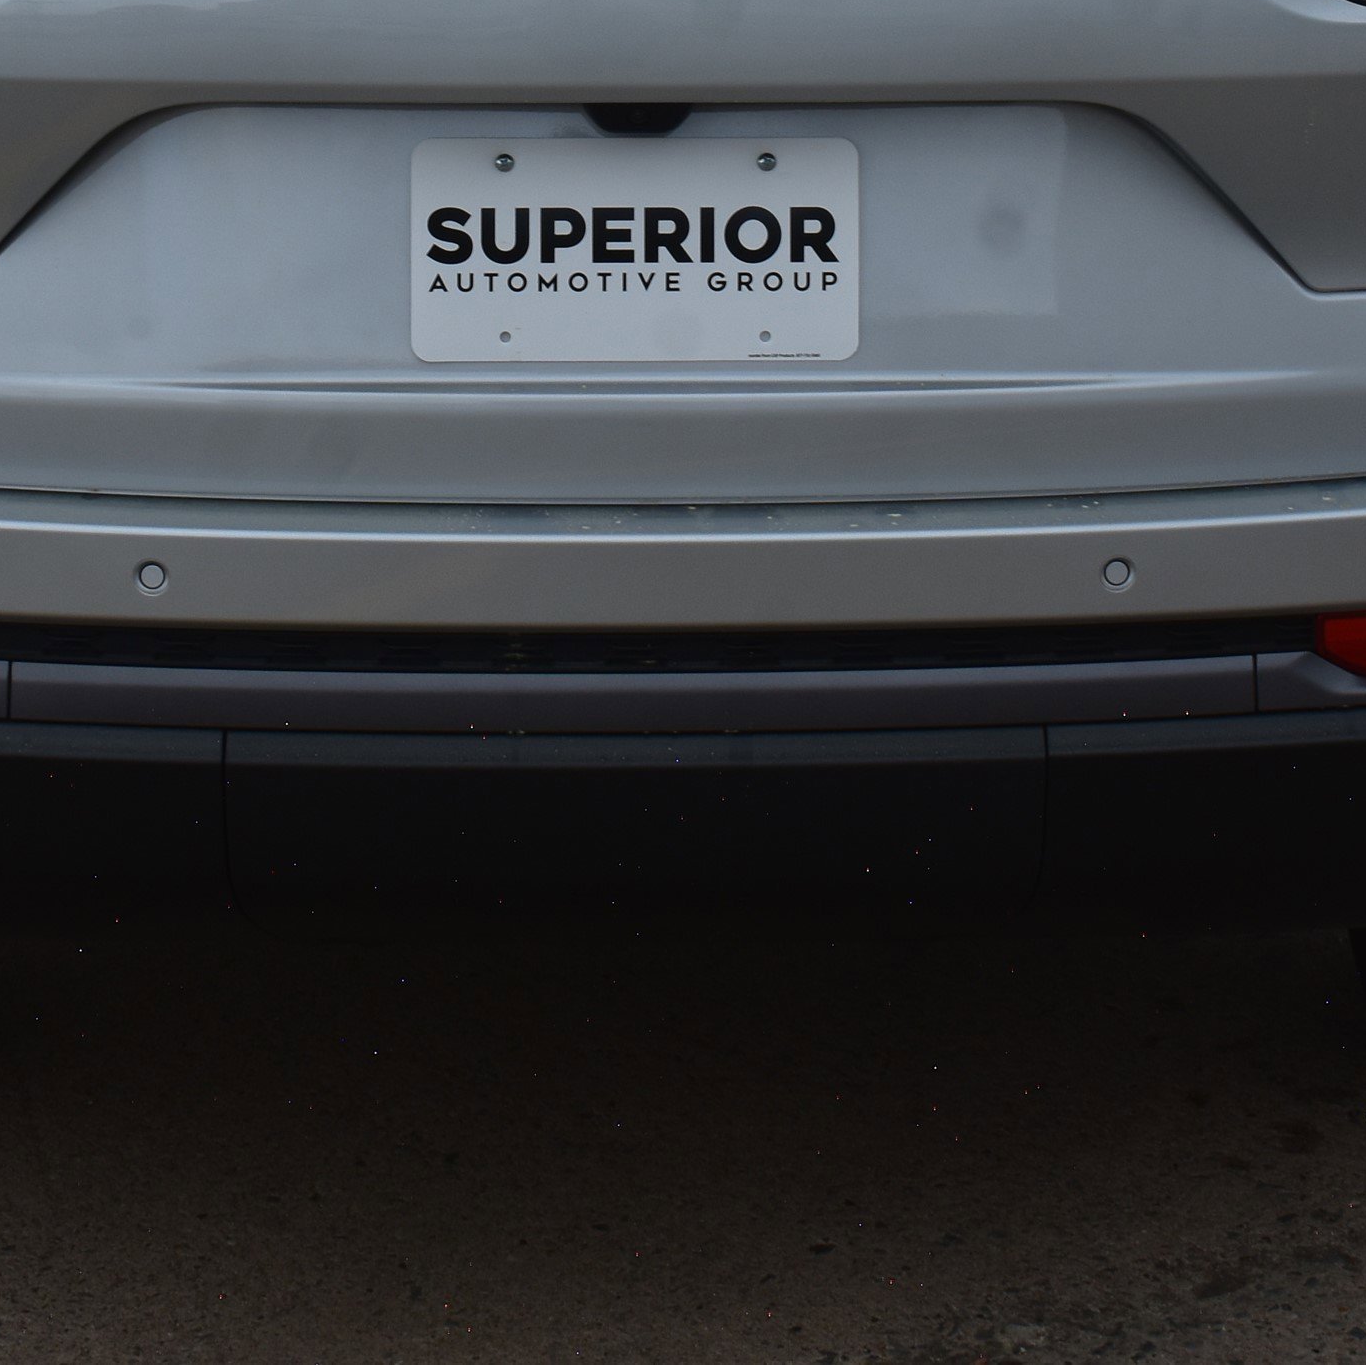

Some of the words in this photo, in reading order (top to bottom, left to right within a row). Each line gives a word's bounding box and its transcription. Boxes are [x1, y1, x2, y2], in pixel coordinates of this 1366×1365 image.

[426, 205, 839, 264] SUPERIOR
[429, 272, 681, 292] AUTOMOTIVE
[707, 271, 838, 292] GROUP
